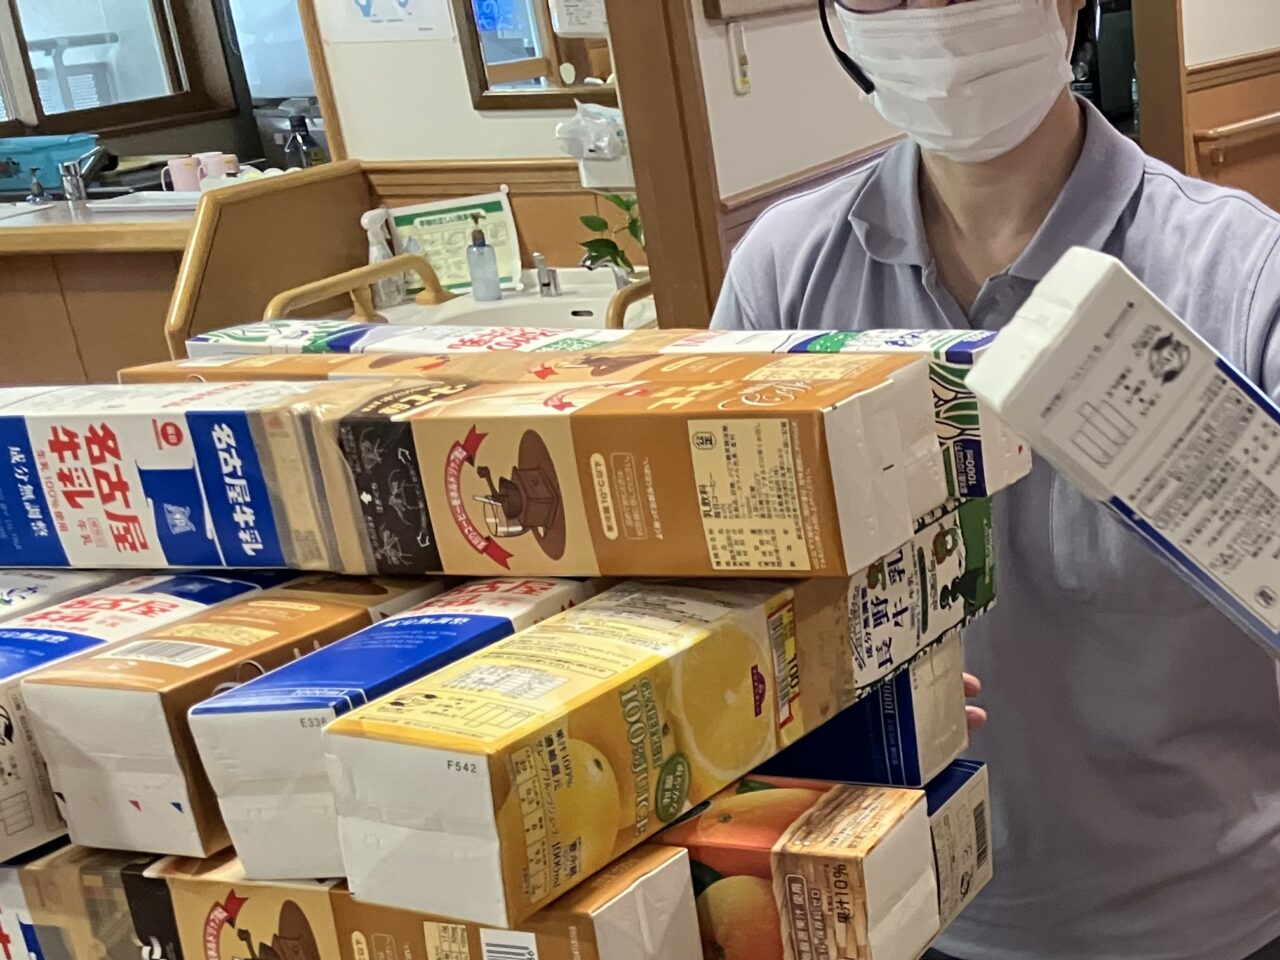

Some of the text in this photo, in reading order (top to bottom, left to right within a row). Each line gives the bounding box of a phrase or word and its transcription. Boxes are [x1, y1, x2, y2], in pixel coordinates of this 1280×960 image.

[48, 424, 96, 510] 牛乳
[84, 422, 149, 553] 名古屋
[211, 422, 264, 556] 名古屋牛乳
[965, 448, 978, 486] 1000ml
[446, 759, 478, 774] F542
[833, 863, 849, 926] 果汁10%
